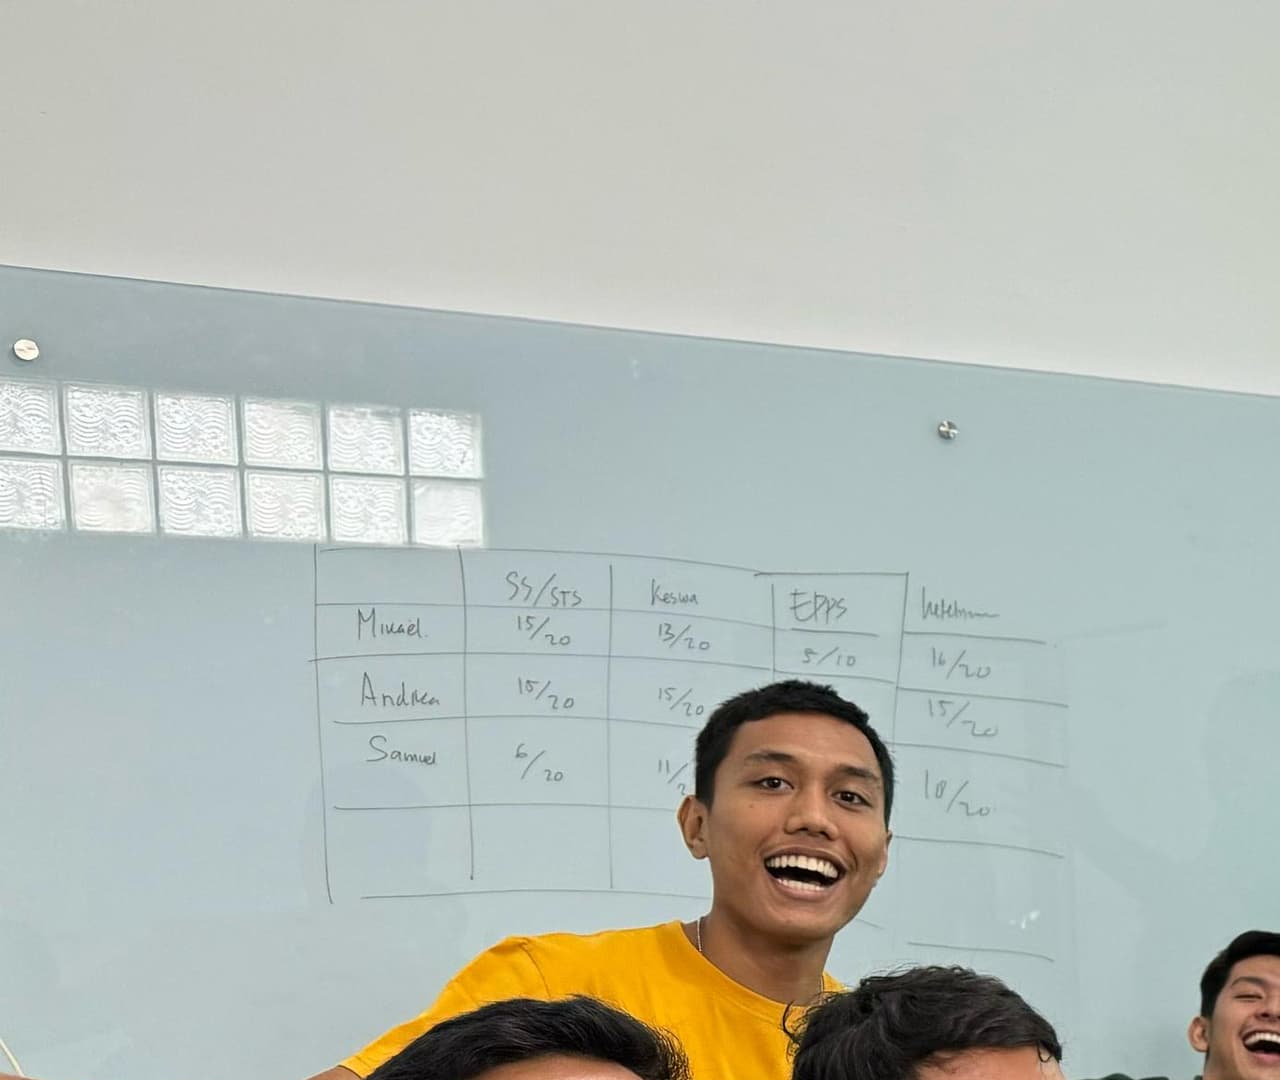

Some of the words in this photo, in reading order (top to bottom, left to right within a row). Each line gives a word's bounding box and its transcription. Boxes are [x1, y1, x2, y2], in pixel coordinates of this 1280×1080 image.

[517, 615, 571, 647] 15/20
[658, 623, 711, 652] 13/20
[514, 743, 564, 783] 6/20
[657, 758, 687, 797] 11/2
